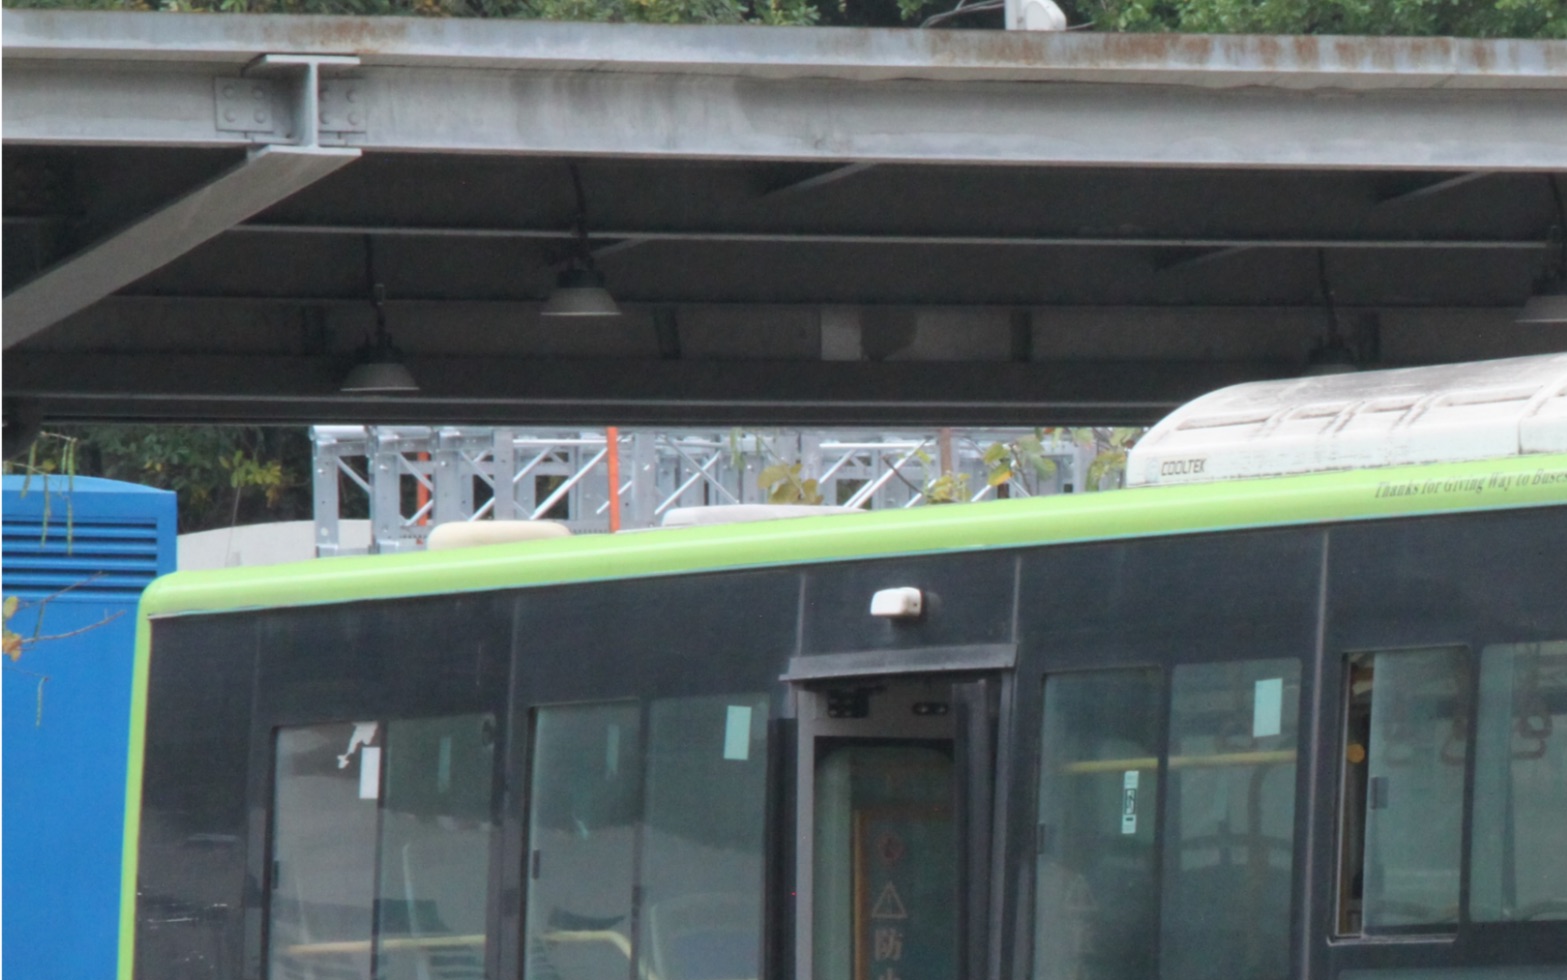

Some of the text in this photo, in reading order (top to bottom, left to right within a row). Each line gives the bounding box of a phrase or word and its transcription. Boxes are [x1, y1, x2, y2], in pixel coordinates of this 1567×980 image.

[1161, 458, 1207, 476] COOLTEK
[1375, 480, 1419, 499] Thanks
[1421, 478, 1441, 495] for
[1444, 477, 1484, 494] Giving
[1487, 472, 1515, 492] Way
[1516, 474, 1530, 487] to
